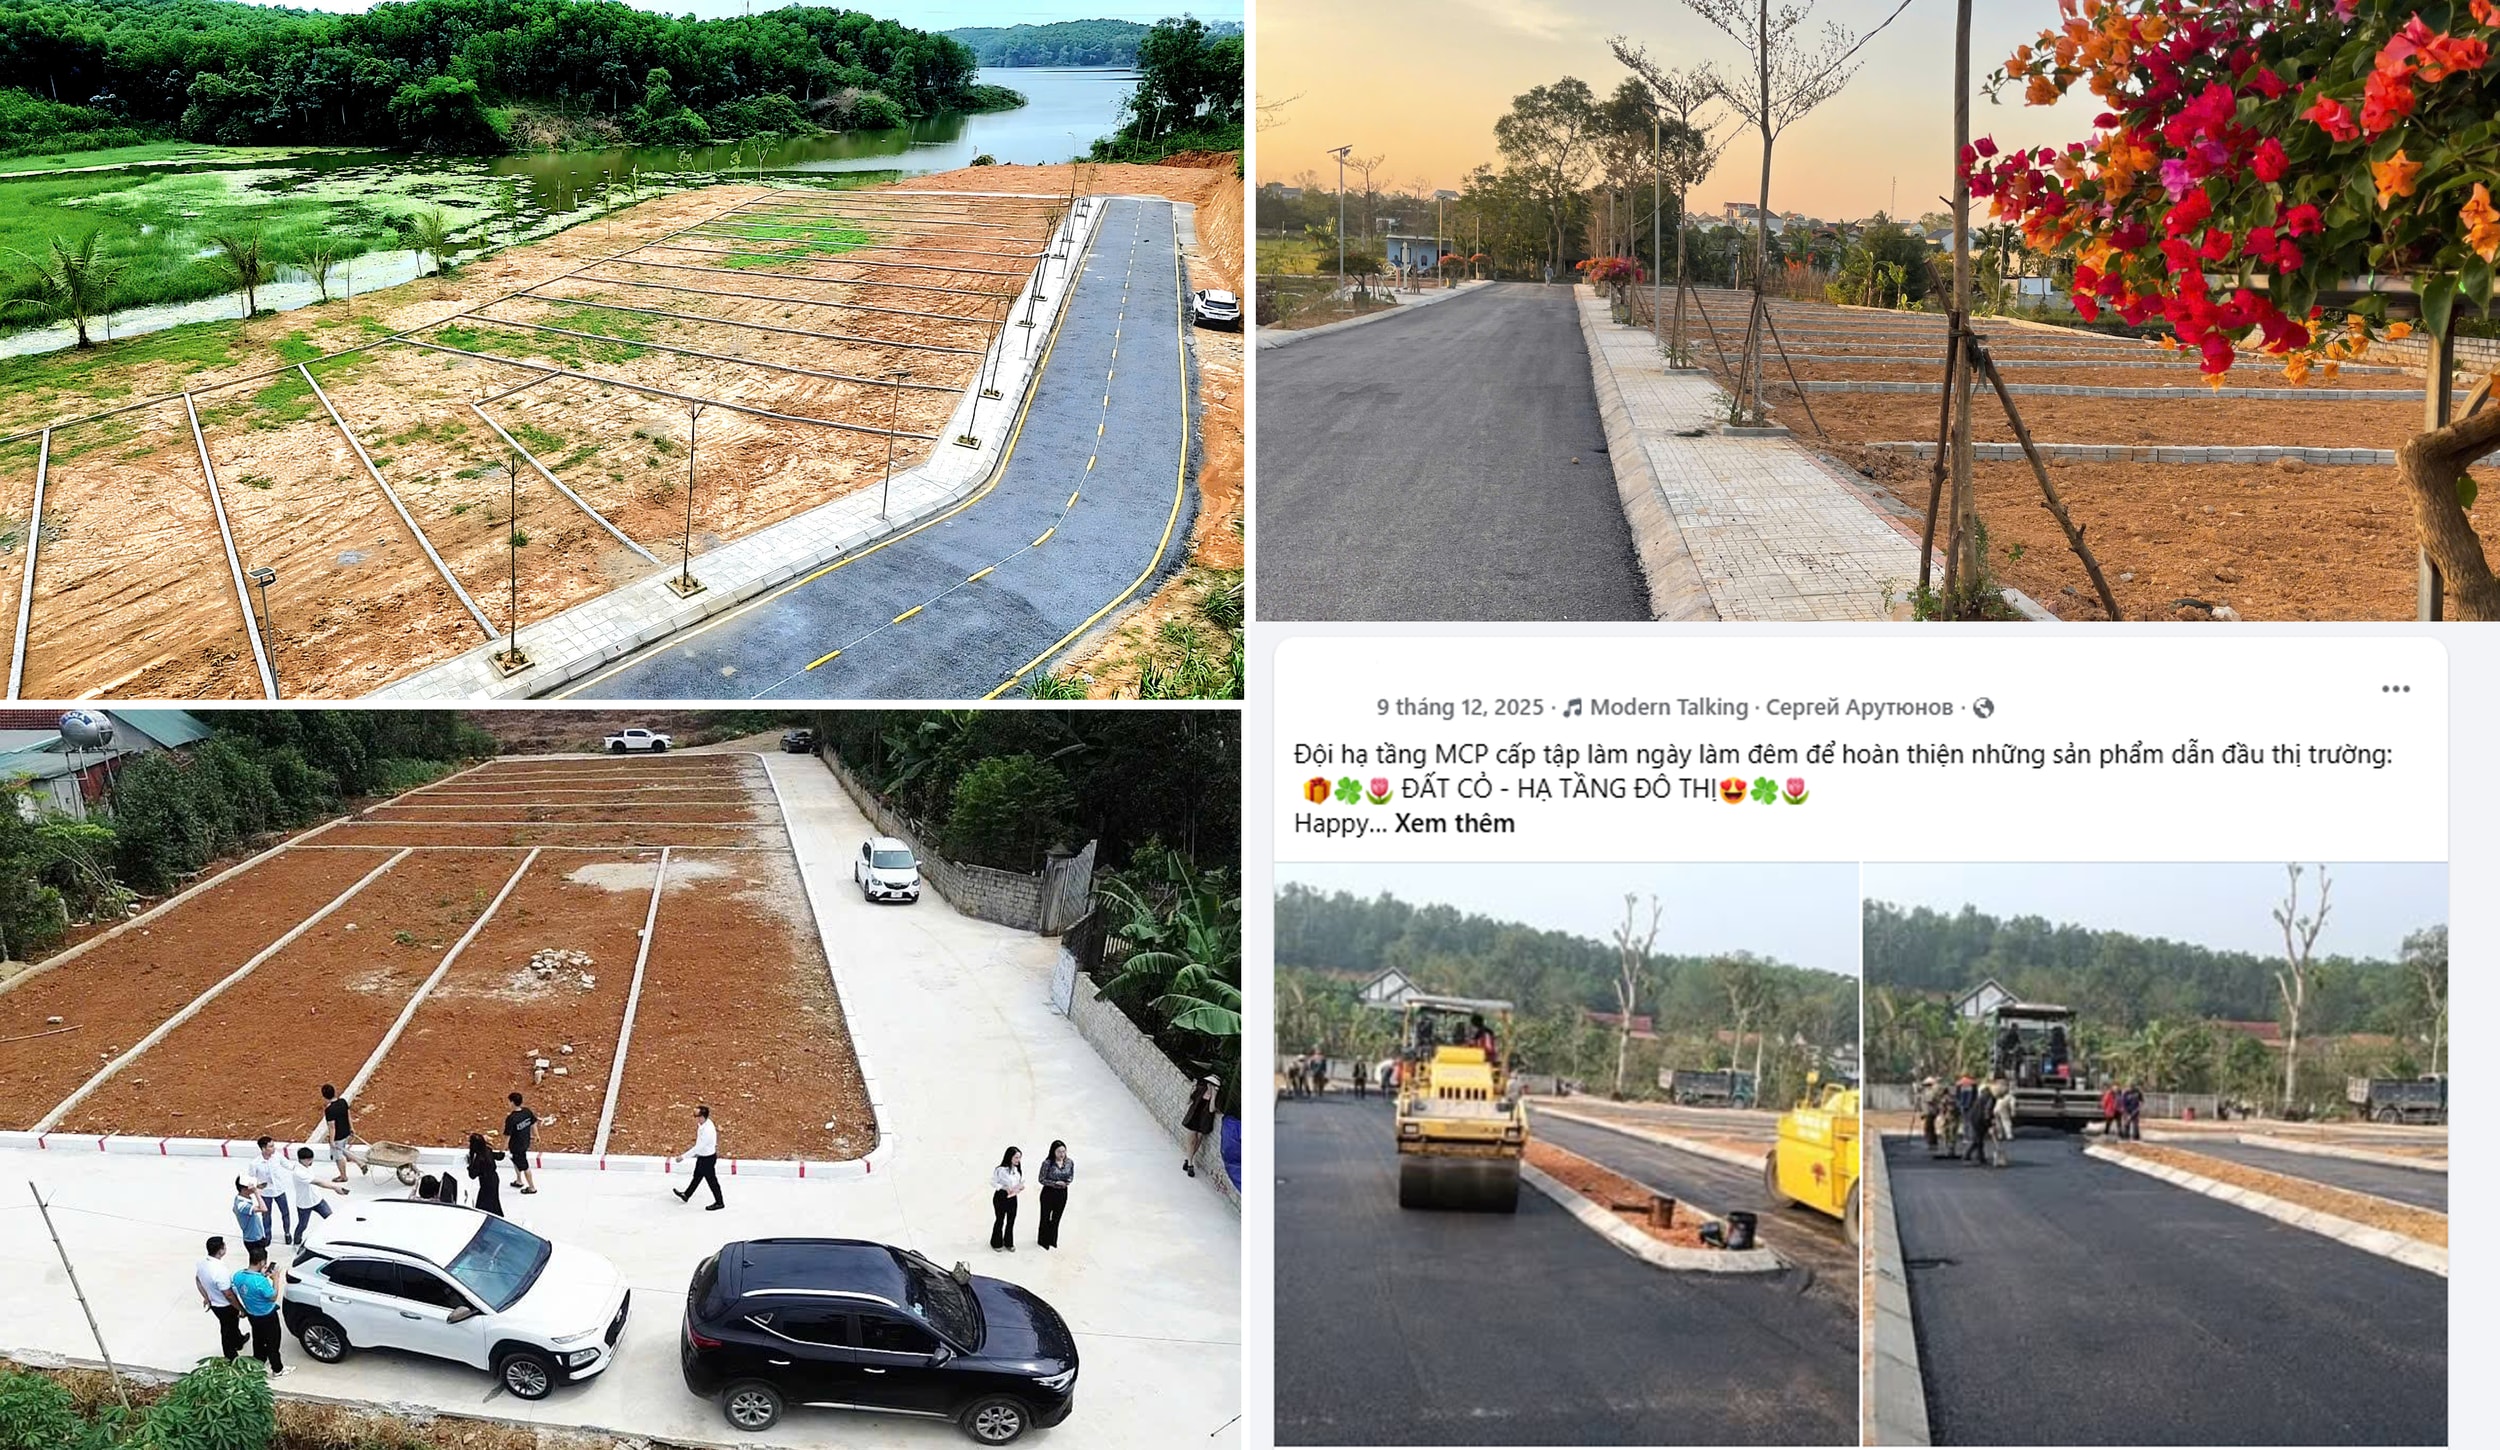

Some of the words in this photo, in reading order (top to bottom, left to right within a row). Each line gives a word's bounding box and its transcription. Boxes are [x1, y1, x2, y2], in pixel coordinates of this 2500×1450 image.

[1378, 699, 1389, 715] 9
[1396, 697, 1454, 720] tháng
[1462, 699, 1487, 718] 12,
[1495, 699, 1543, 715] 2025
[1591, 697, 1670, 715] Modern
[1677, 697, 1748, 720] Talking
[1767, 697, 1838, 720] Сергей
[1846, 699, 1953, 720] Арутюнов
[1294, 742, 1332, 767] Đội
[1342, 744, 1367, 767] hạ
[1376, 742, 1426, 769] tầng
[1433, 744, 1488, 764] MCP
[1496, 742, 1535, 769] cấp
[1543, 744, 1580, 769] tập
[1588, 744, 1627, 764] làm
[1637, 744, 1692, 769] ngày
[1700, 744, 1739, 764] làm
[1748, 744, 1797, 764] đêm
[1807, 740, 1836, 764] để
[1843, 744, 1899, 764] hoàn
[1907, 744, 1963, 767] thiện
[1973, 744, 2044, 769] những
[2053, 742, 2091, 764] sản
[2100, 740, 2163, 769] phẩm
[2172, 738, 2214, 764] dẫn
[2222, 742, 2264, 764] đầu
[2272, 744, 2300, 767] thị
[2308, 744, 2391, 769] trường:
[1401, 771, 1450, 798] ĐẤT
[1458, 771, 1492, 798] CỎ
[1519, 779, 1552, 801] HẠ
[1559, 771, 1625, 798] TẦNG
[1634, 773, 1670, 798] ĐÔ
[1679, 779, 1717, 801] THỊ
[1296, 813, 1387, 838] Happy...
[1395, 814, 1446, 833] Xem
[1455, 813, 1514, 833] thêm
